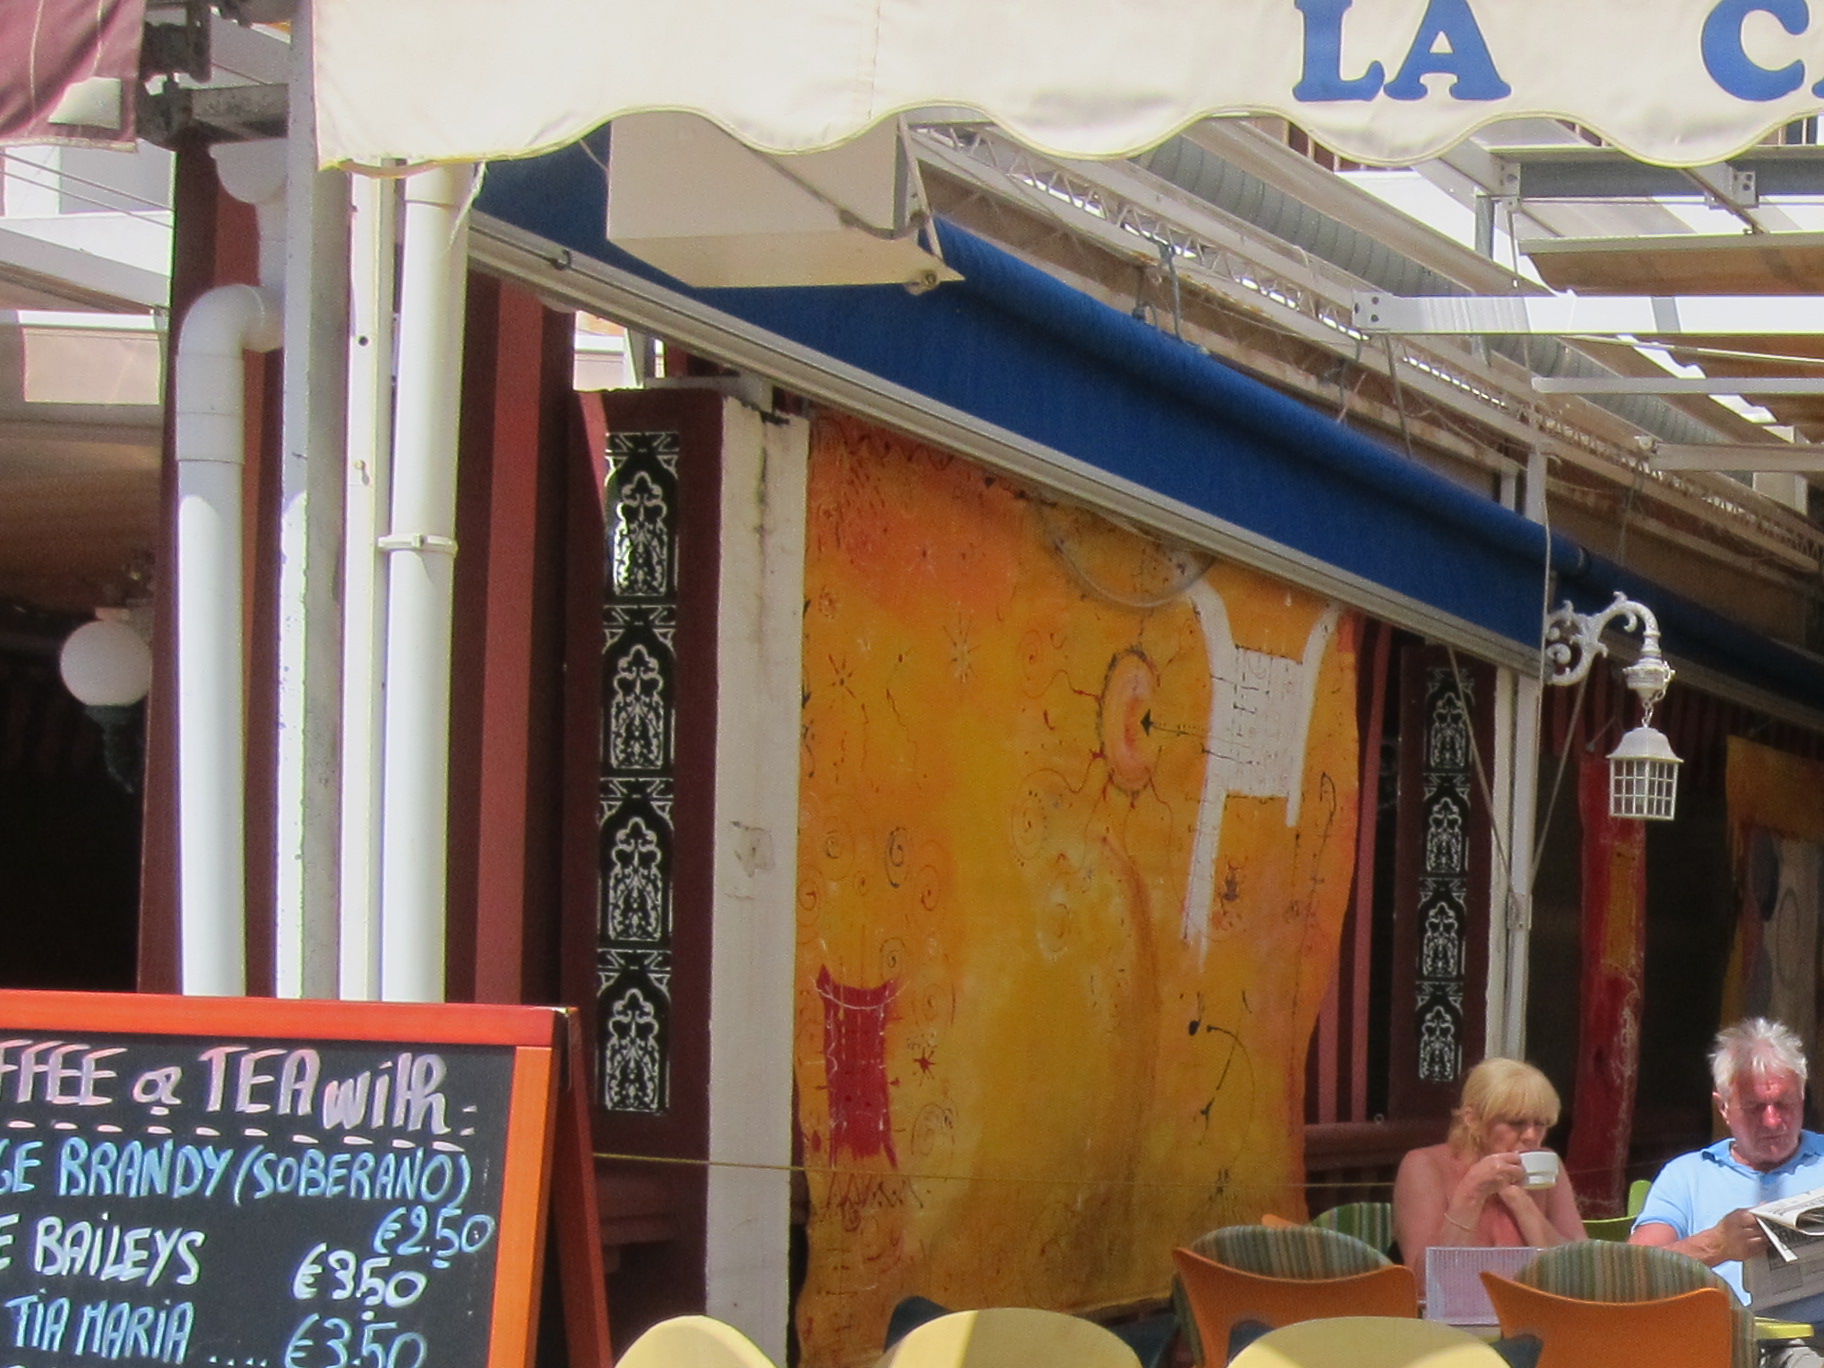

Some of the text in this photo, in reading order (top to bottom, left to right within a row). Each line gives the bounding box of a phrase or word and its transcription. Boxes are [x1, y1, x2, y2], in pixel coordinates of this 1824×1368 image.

[1292, 0, 1512, 102] LA
[199, 1047, 321, 1116] TEA
[58, 1137, 235, 1199] BRANDY
[233, 1145, 473, 1206] (SOBERANO)
[372, 1205, 496, 1258] €2.50
[293, 1242, 428, 1308] €3.50
